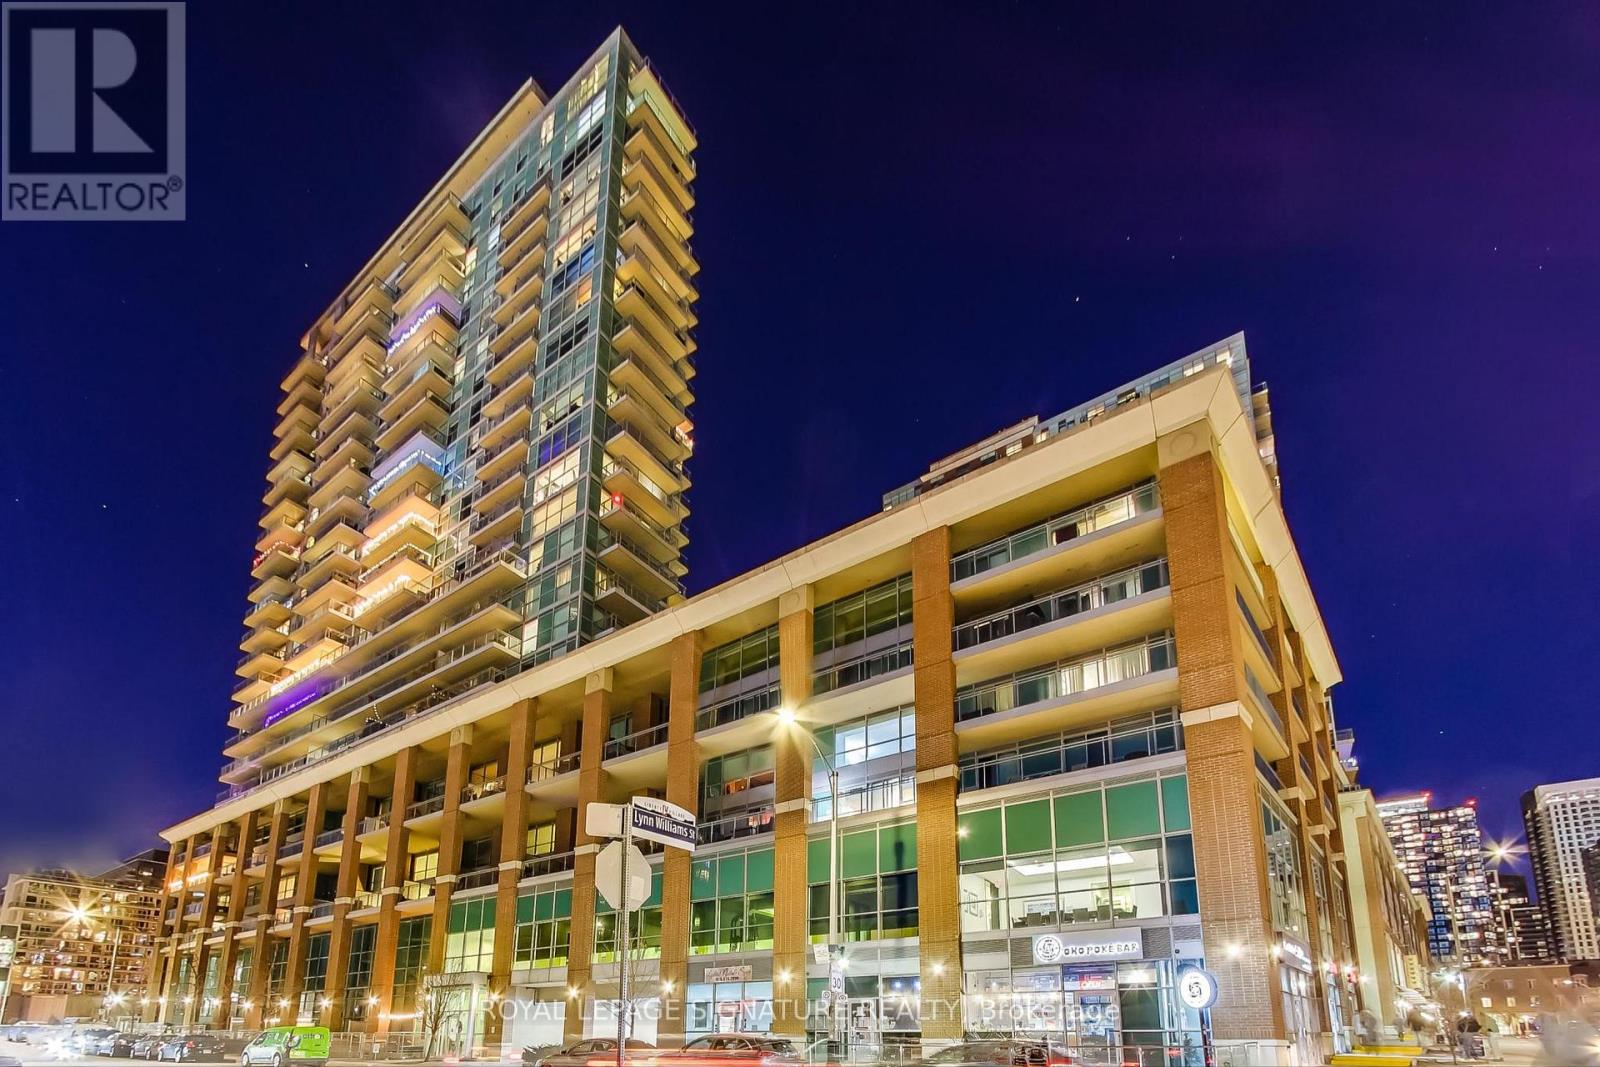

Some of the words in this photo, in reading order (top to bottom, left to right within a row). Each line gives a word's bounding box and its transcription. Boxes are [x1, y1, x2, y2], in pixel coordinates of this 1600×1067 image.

[634, 810, 654, 826] Lynn
[655, 816, 687, 837] Williams
[688, 829, 695, 839] St
[1116, 943, 1138, 952] BAR
[832, 977, 842, 990] 30
